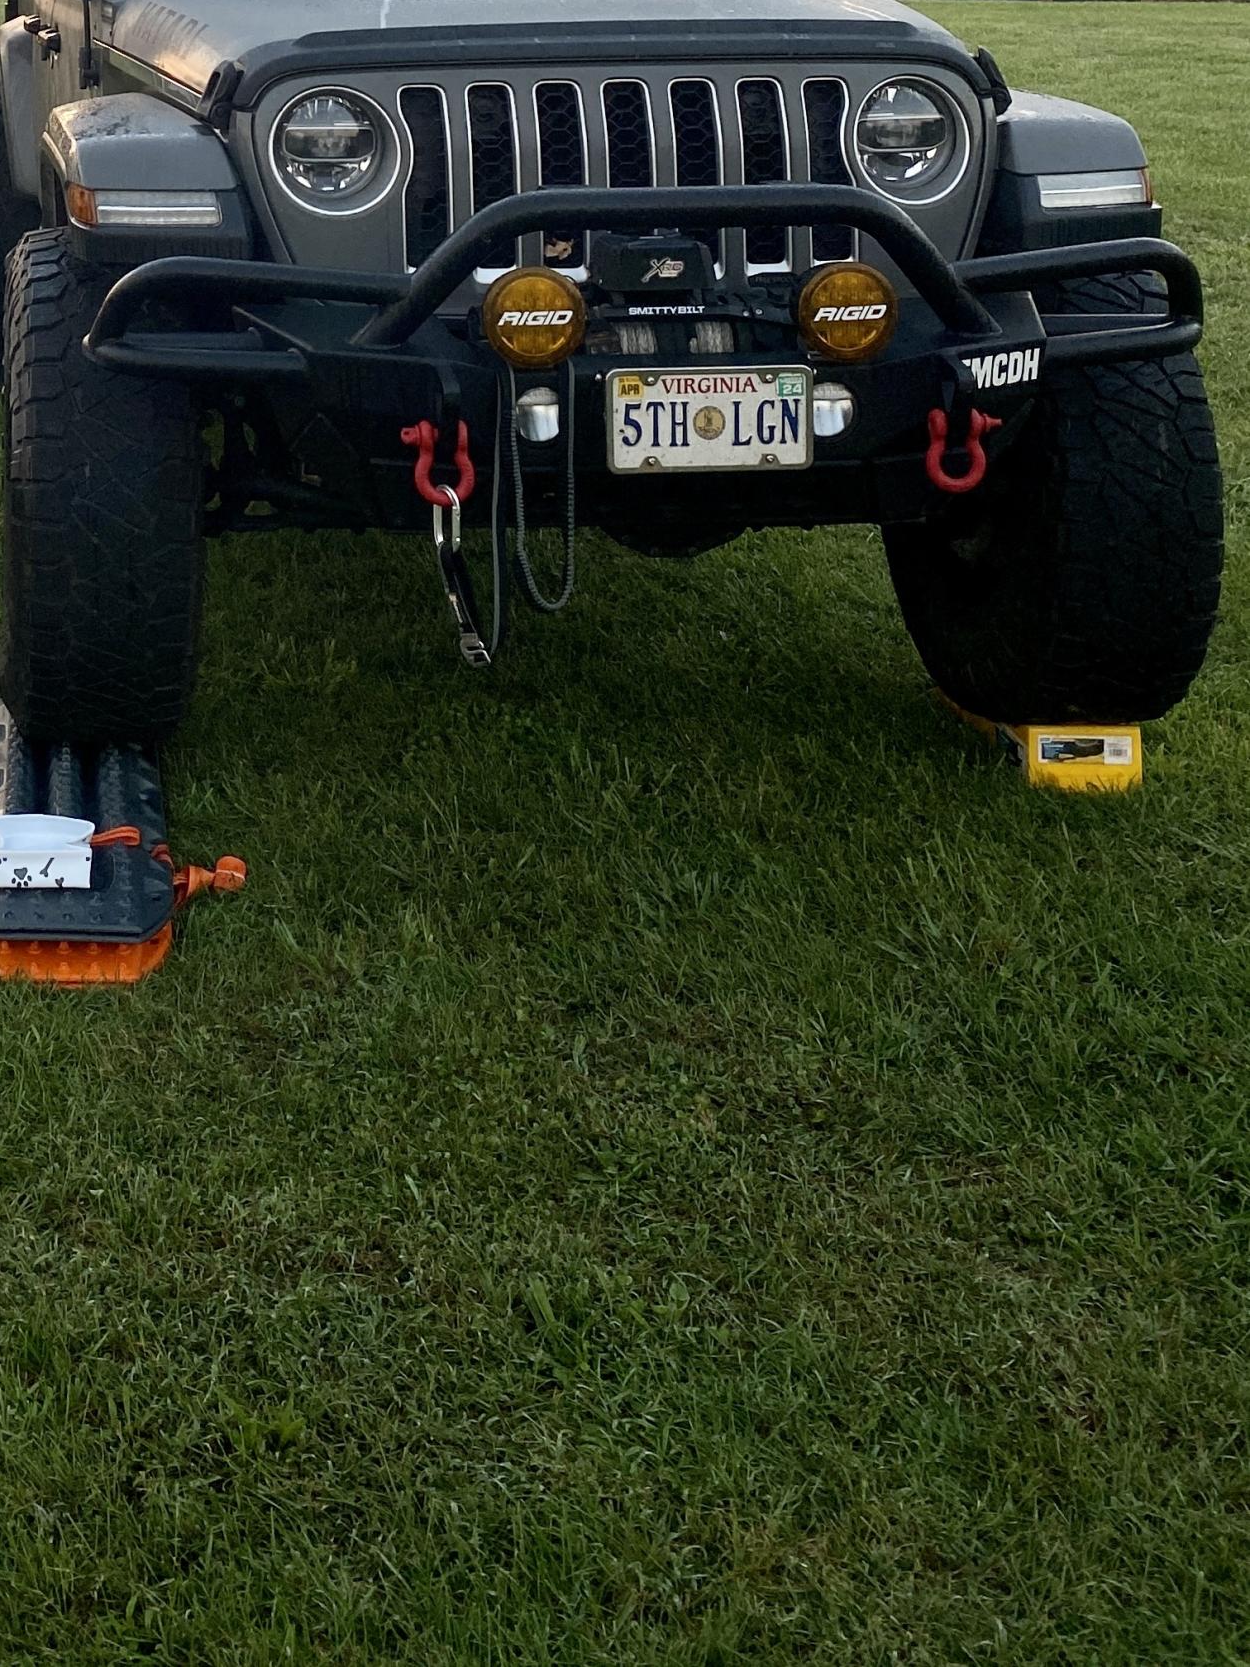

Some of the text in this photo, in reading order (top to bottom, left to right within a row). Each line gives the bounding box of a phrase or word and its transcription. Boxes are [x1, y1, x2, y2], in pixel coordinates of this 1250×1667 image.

[497, 310, 574, 326] RIGID
[628, 306, 706, 316] SMITTYBILT
[813, 304, 888, 322] RIGID
[620, 384, 640, 396] APR
[661, 376, 758, 395] VIRGINIA
[782, 383, 803, 395] 24
[621, 398, 801, 447] 5TH LGN
